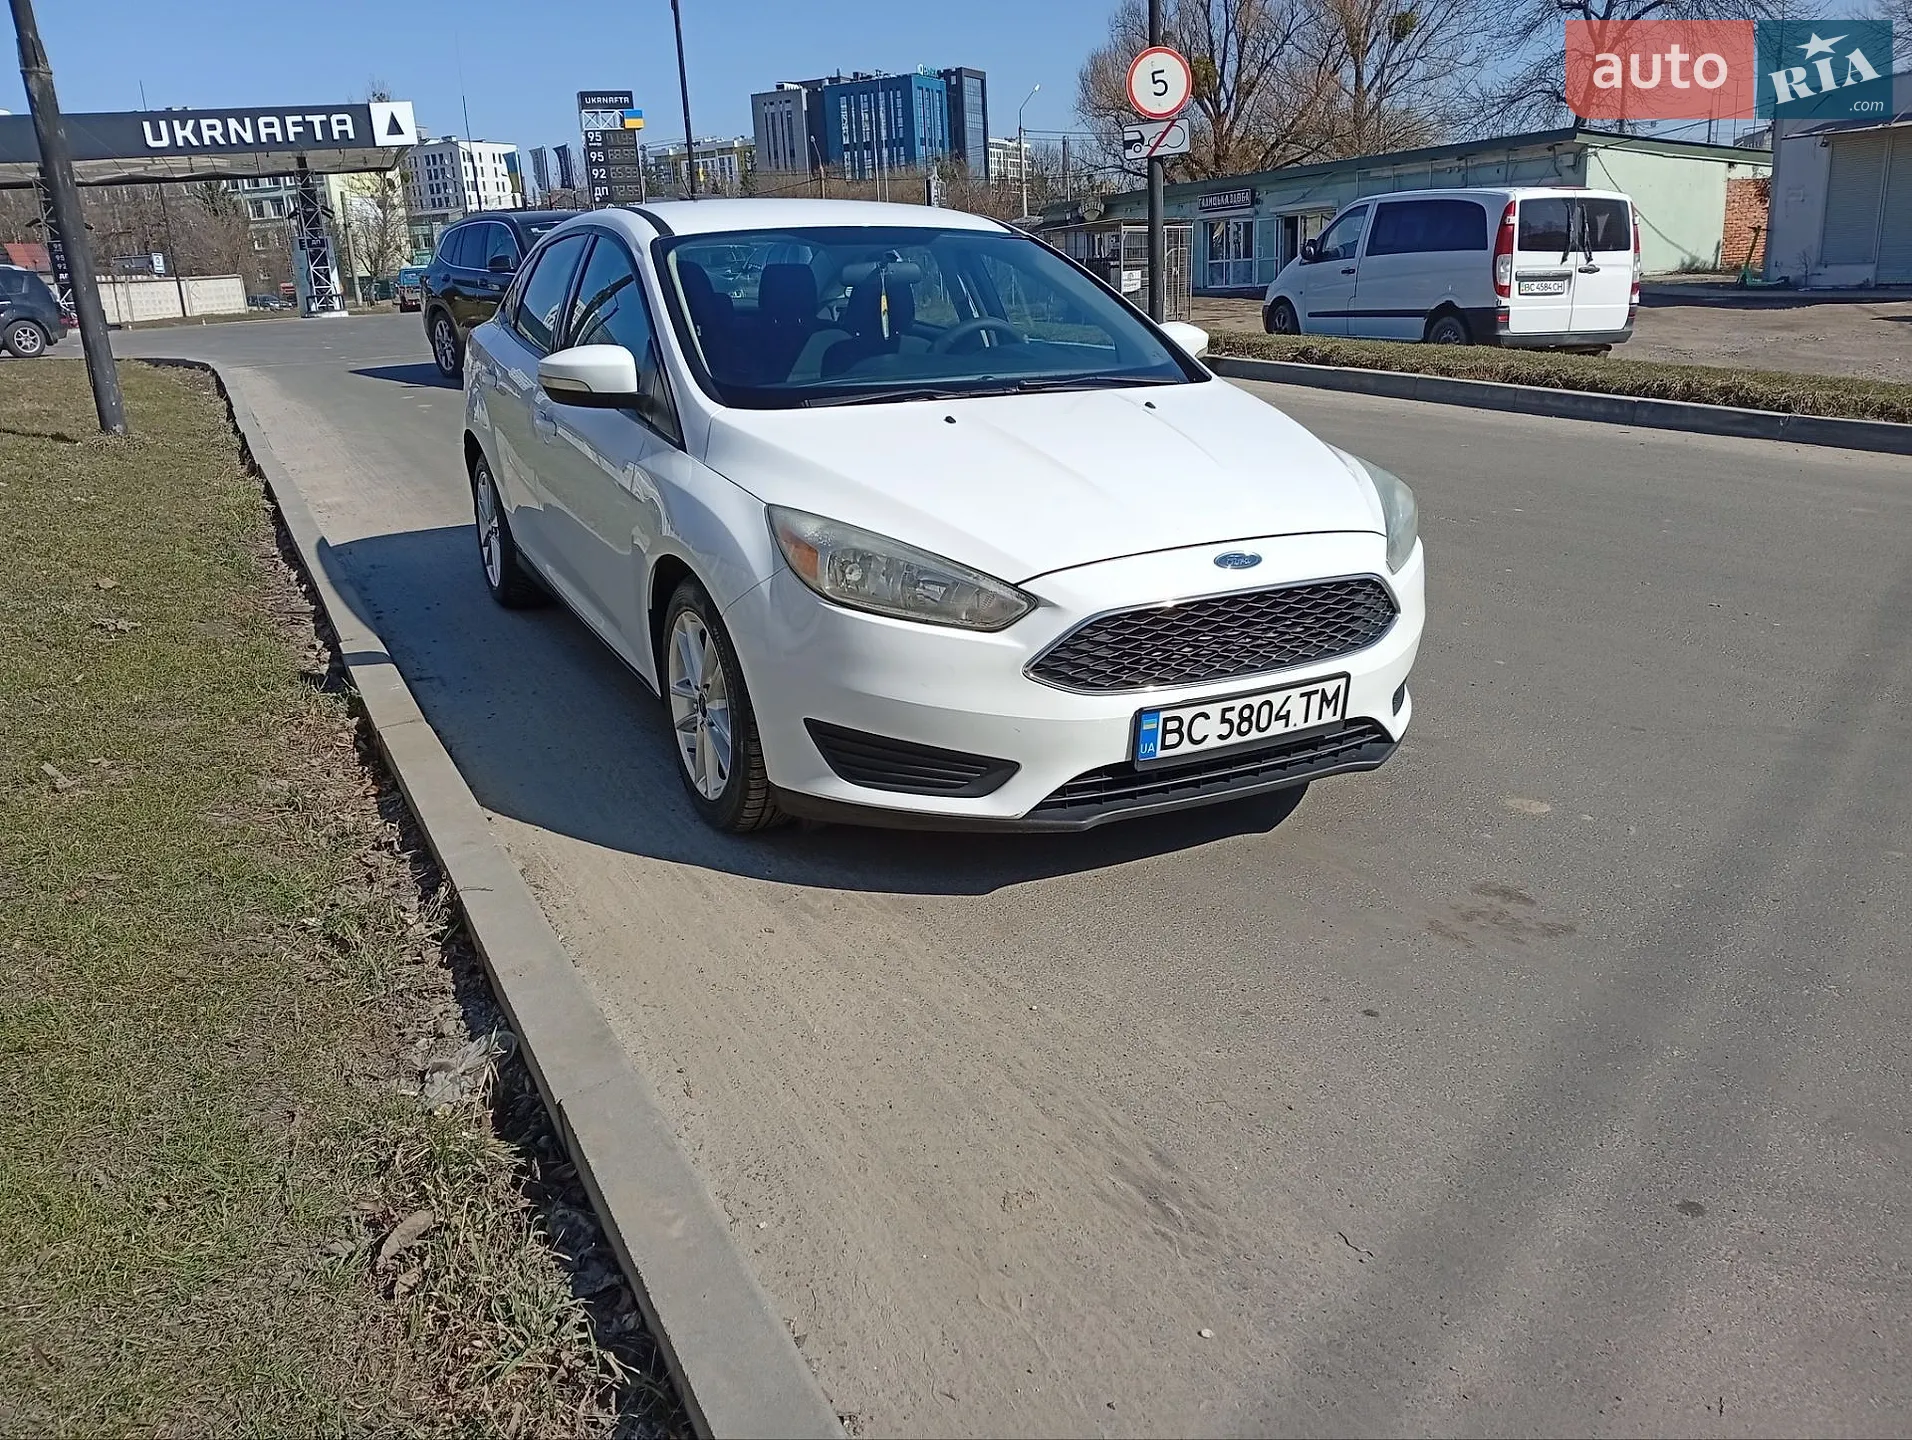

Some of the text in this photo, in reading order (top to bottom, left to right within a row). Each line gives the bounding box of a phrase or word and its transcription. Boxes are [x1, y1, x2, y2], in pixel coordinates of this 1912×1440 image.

[1151, 69, 1169, 97] 5
[142, 113, 355, 148] UKRNAFTA
[588, 132, 602, 142] 95
[590, 152, 604, 162] 95
[592, 169, 606, 179] 92
[594, 187, 609, 198] ДП
[1536, 282, 1552, 291] 4584
[1160, 684, 1341, 751] BC 5804 TM
[1140, 743, 1155, 754] UA
